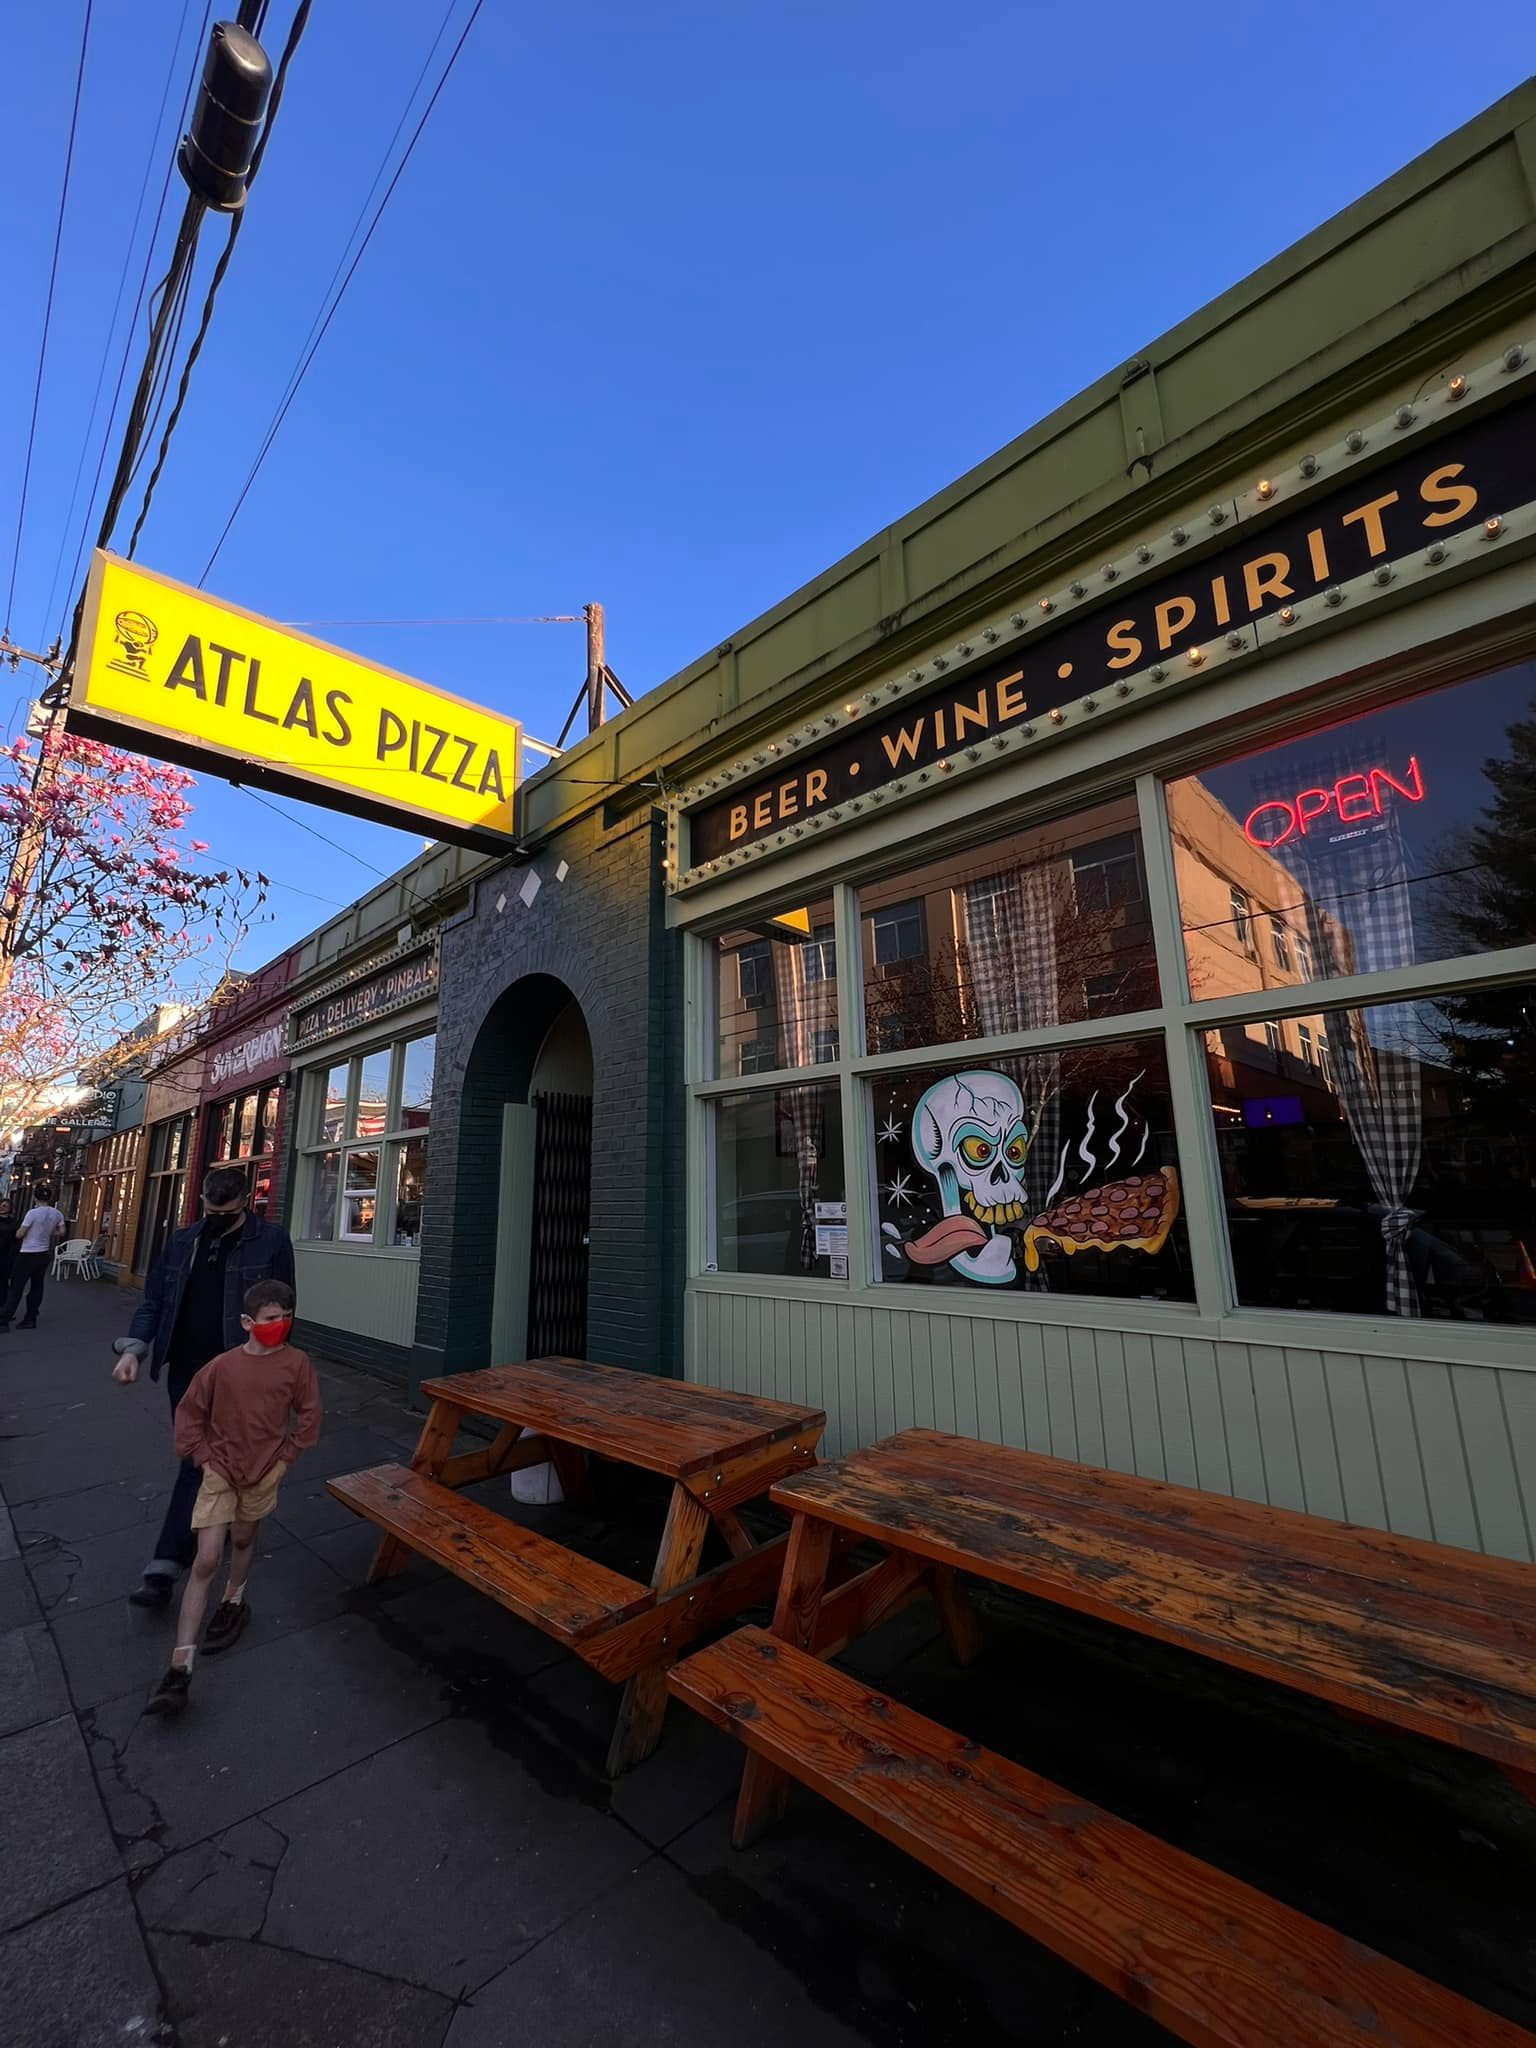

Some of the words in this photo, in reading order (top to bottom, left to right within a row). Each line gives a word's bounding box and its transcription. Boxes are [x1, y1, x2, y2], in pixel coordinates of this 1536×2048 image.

[729, 768, 829, 841] BEER
[881, 669, 1028, 769] WINE
[1105, 463, 1479, 670] SPIRITS
[164, 633, 353, 747] ATLAS
[376, 707, 506, 803] PIZZA
[1244, 755, 1424, 848] OPEN
[327, 985, 378, 1023] DELIVERY
